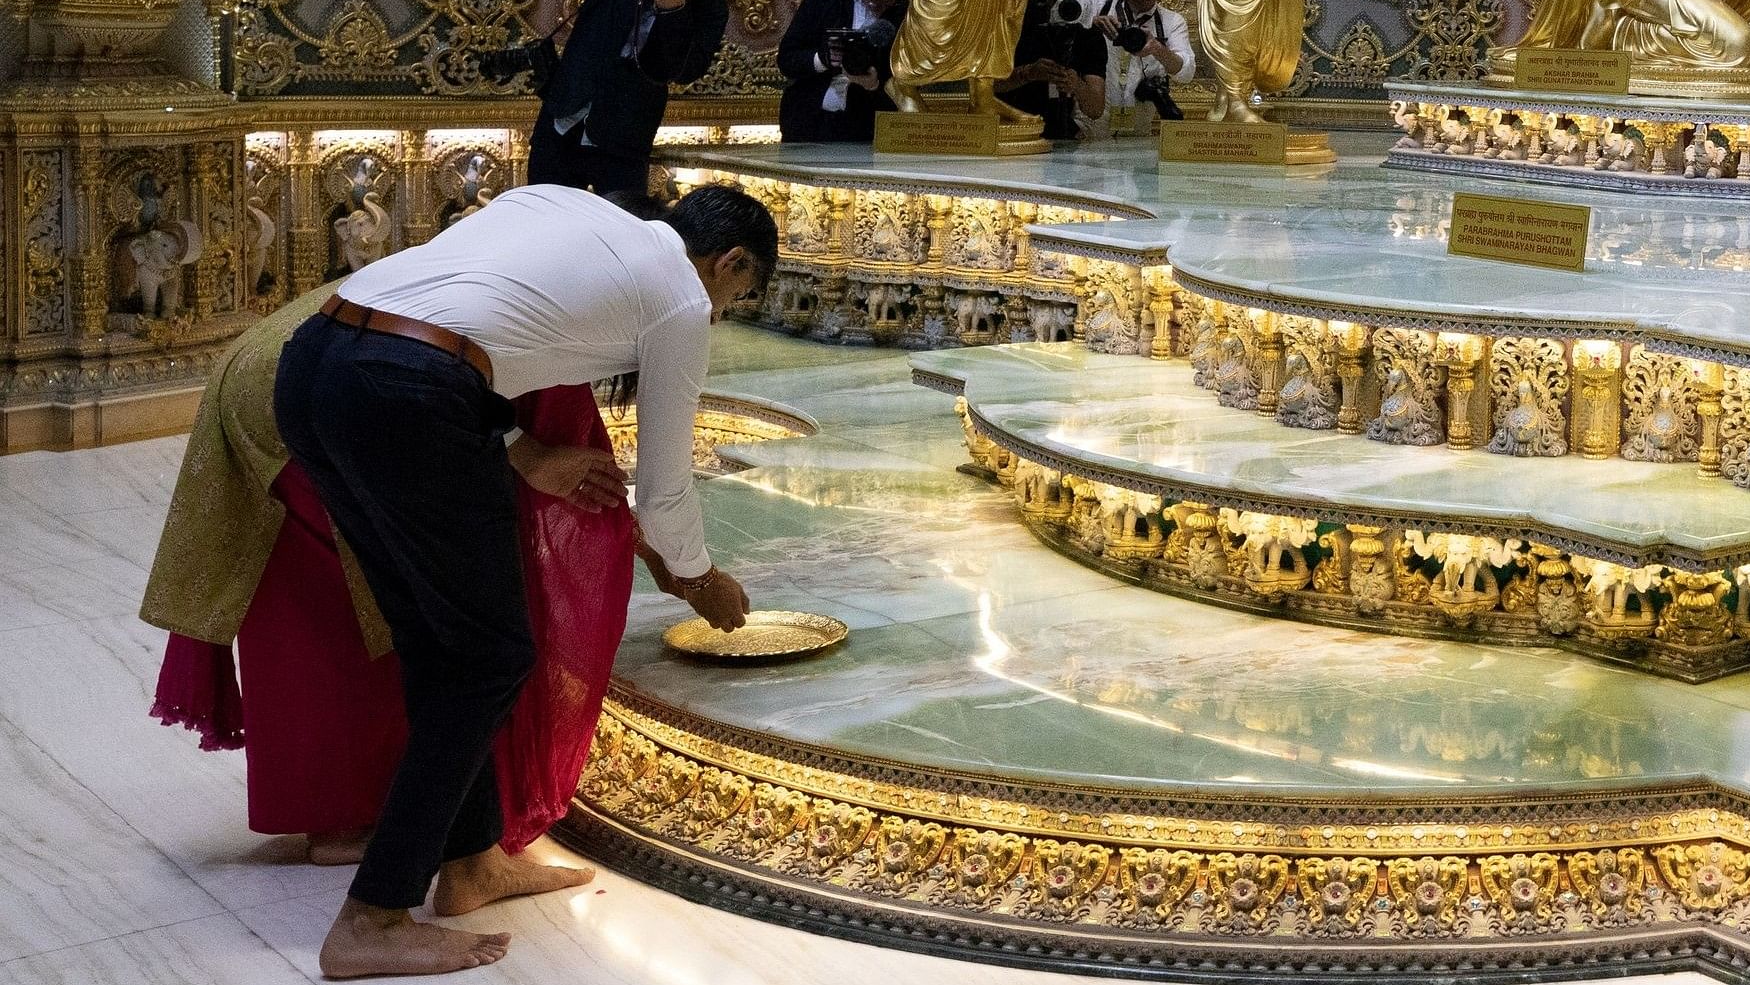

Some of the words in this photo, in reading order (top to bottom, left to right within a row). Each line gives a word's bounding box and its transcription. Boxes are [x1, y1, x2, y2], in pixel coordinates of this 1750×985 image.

[1507, 212, 1515, 223] श्री
[1517, 214, 1558, 228] स्वामिनारायण
[1560, 221, 1583, 232] भगवान
[1457, 234, 1474, 245] SHRI
[1476, 238, 1535, 252] SWAMINARAYAN
[1536, 244, 1576, 257] BHAGWAN
[1463, 225, 1514, 239] PARABRAHMA
[1516, 231, 1572, 246] PURUSHOTTAM
